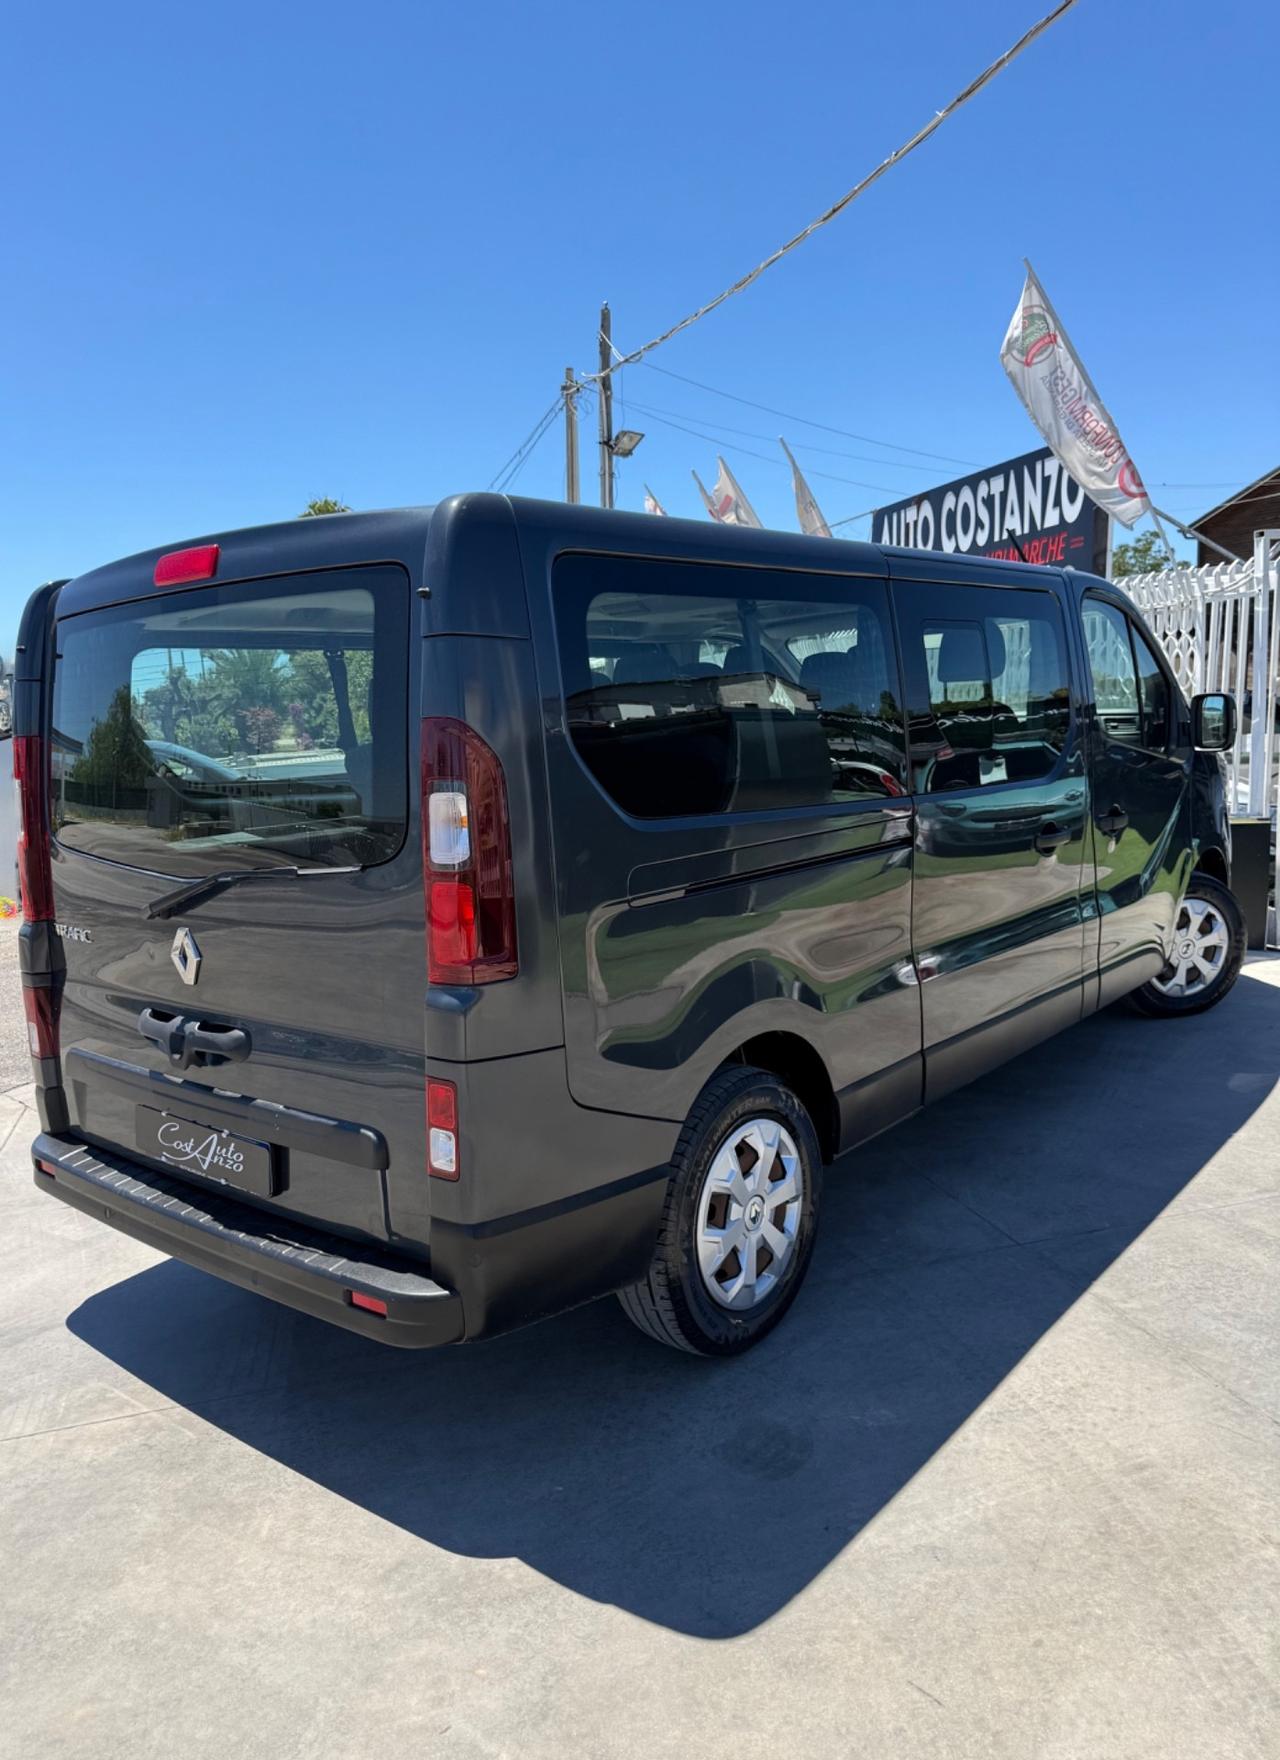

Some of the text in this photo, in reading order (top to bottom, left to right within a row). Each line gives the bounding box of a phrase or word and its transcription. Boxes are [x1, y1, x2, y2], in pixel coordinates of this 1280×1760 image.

[881, 456, 1085, 552] AUTO COSTANZO
[53, 922, 93, 944] TRAFIC
